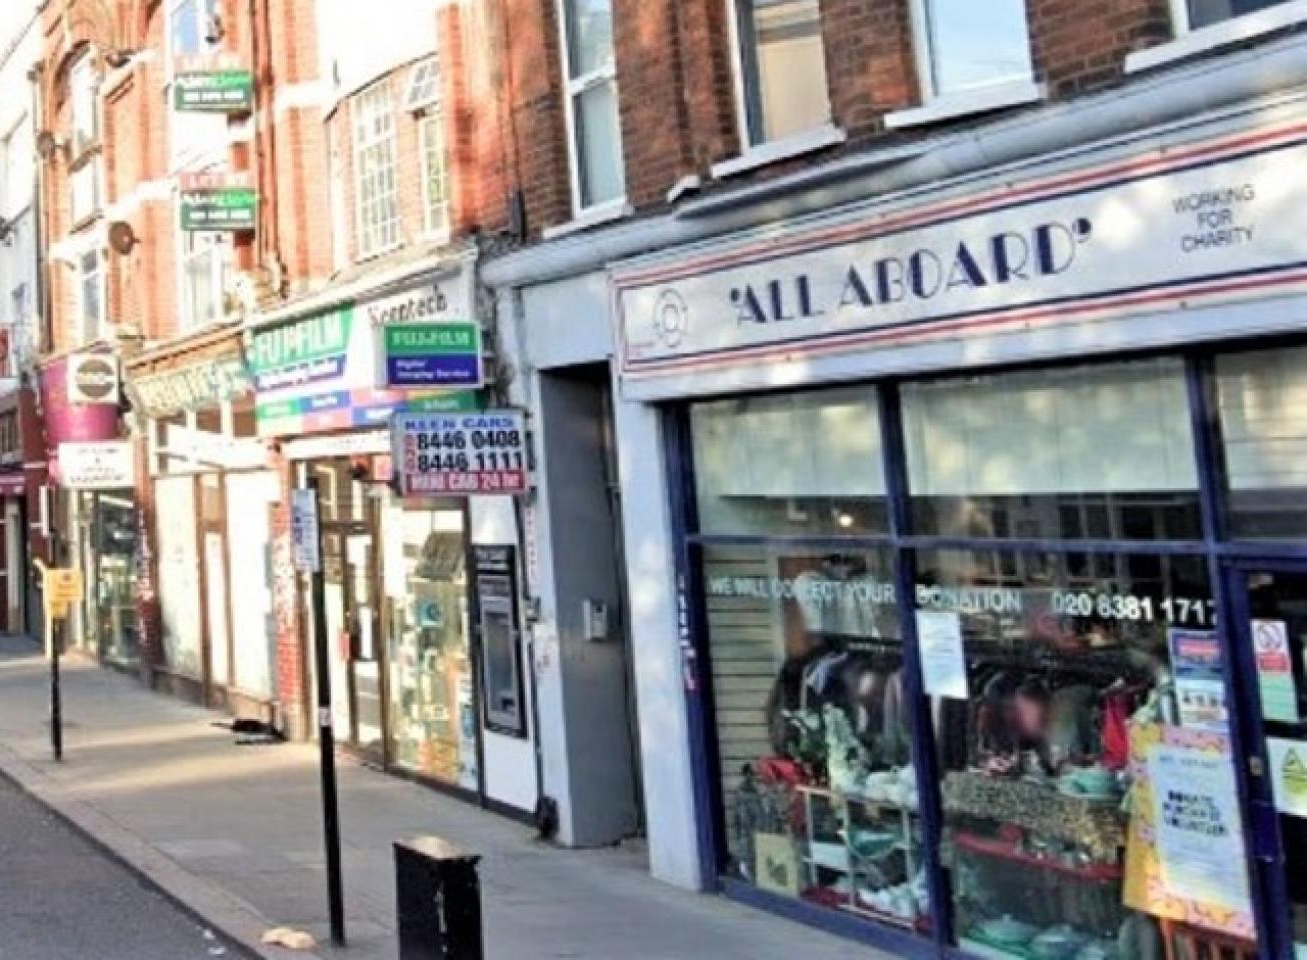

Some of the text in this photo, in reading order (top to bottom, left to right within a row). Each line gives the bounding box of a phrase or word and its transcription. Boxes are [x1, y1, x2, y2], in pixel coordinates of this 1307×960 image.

[1171, 183, 1255, 213] WORKING
[1197, 207, 1233, 229] FOR
[1181, 224, 1254, 253] CHARITY
[393, 331, 470, 346] FUJIFILM
[461, 418, 515, 429] CARS
[474, 451, 523, 471] 1111
[774, 579, 840, 601] COECT
[1052, 591, 1093, 617] 020
[1097, 594, 1154, 621] 8381
